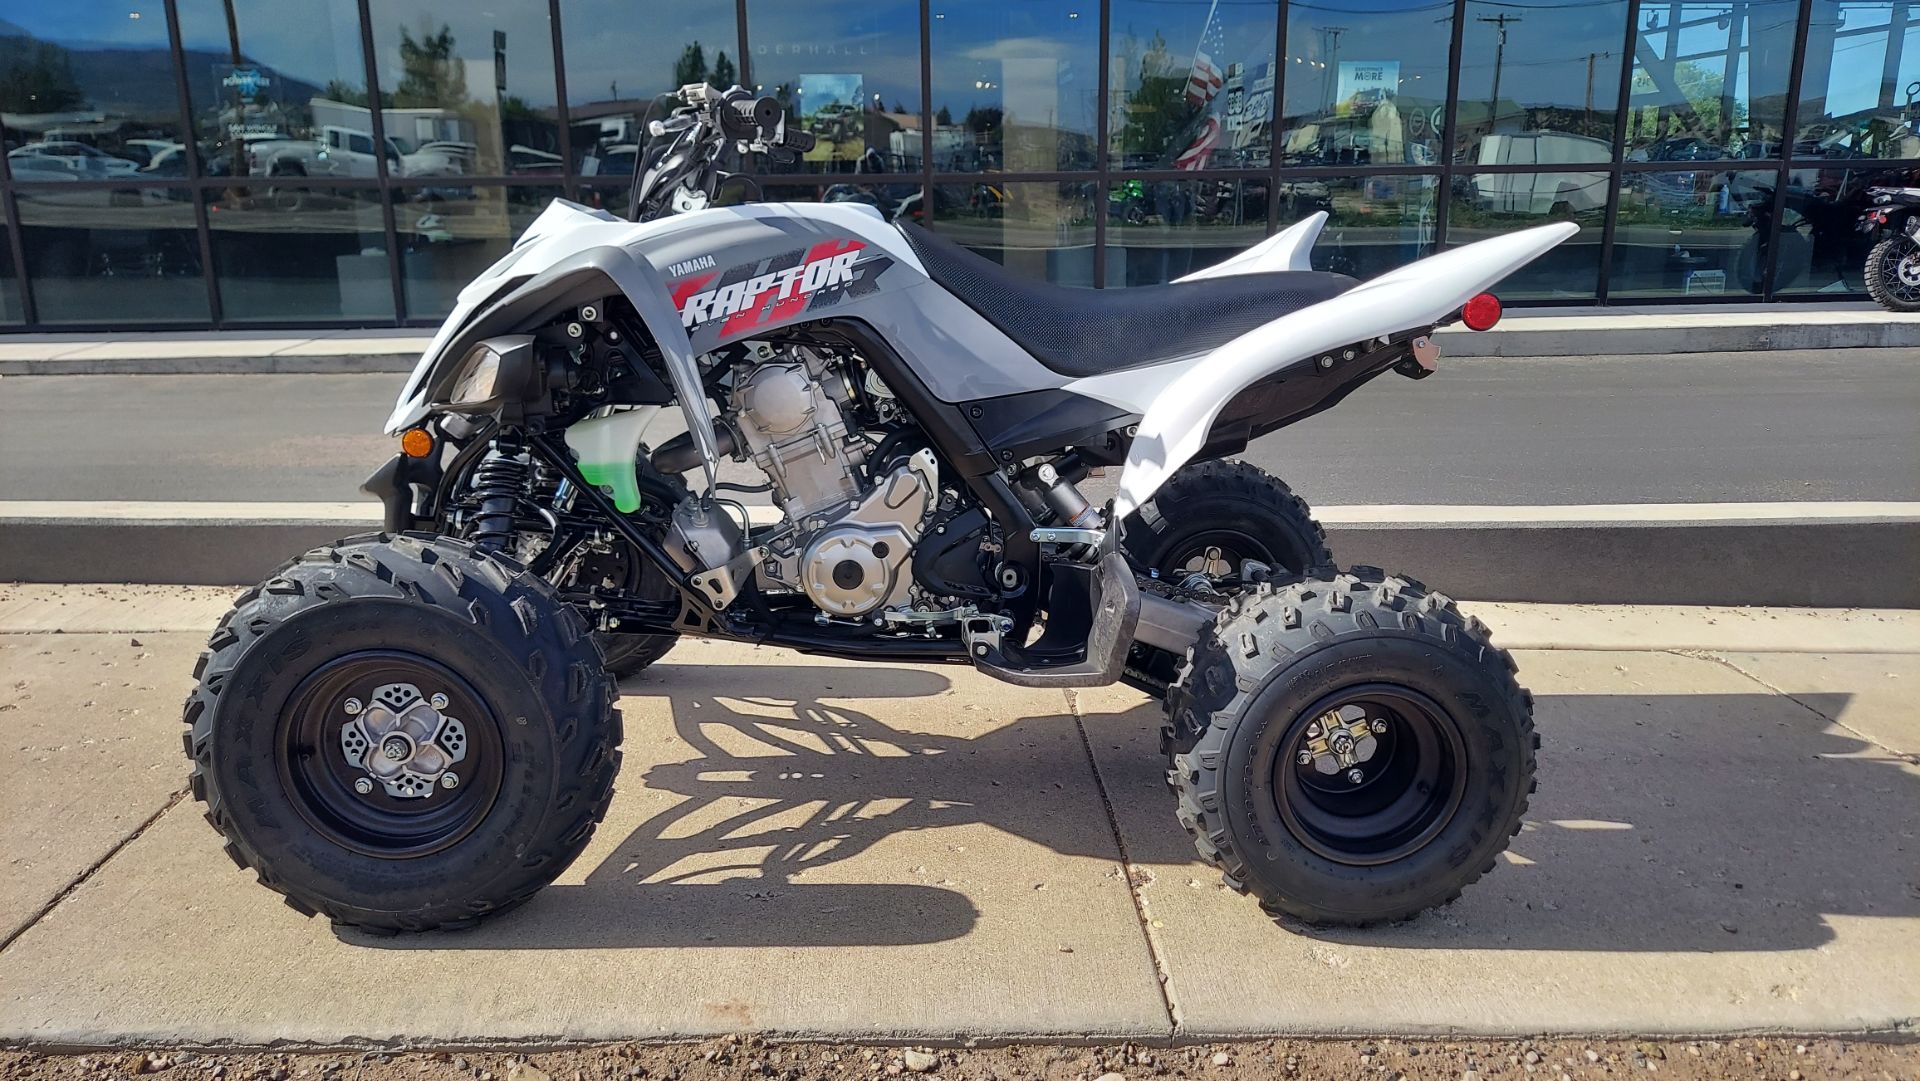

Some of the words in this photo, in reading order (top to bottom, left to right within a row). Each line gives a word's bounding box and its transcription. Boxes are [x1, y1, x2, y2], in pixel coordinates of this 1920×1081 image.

[705, 44, 868, 56] VADERHALL
[1354, 71, 1383, 80] MORE
[668, 254, 717, 278] YAMAHA
[680, 250, 862, 327] RAPTOR
